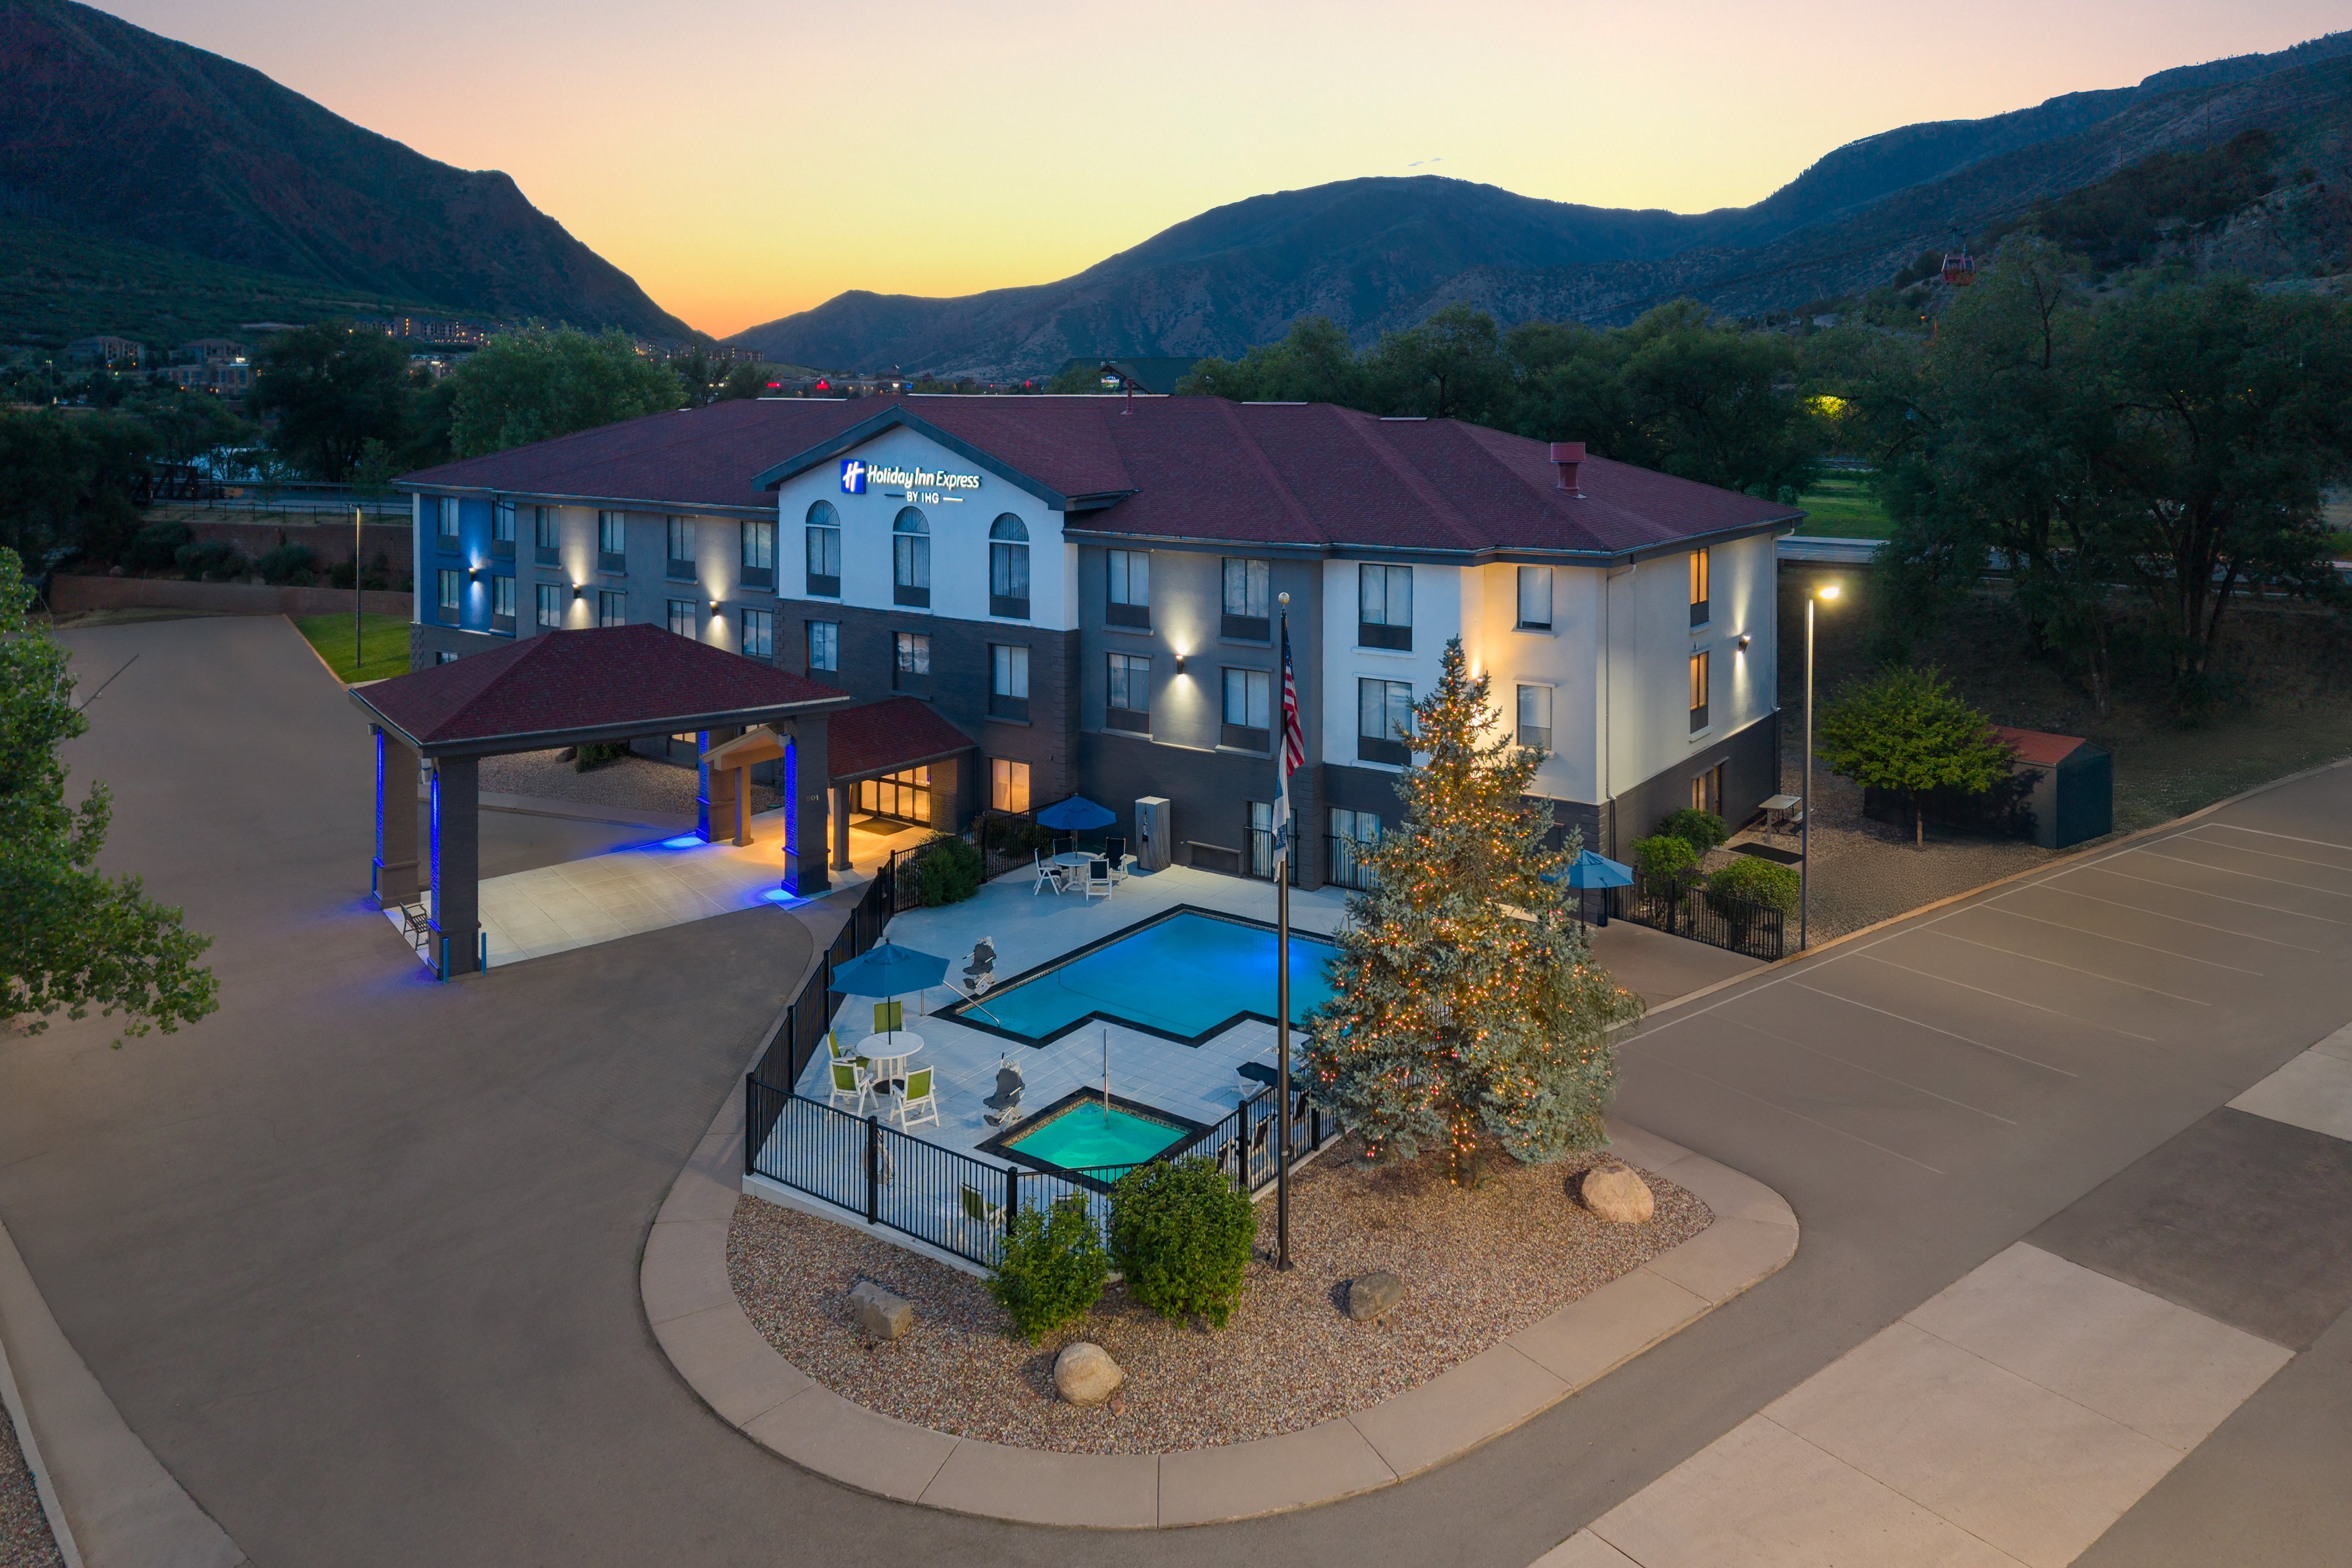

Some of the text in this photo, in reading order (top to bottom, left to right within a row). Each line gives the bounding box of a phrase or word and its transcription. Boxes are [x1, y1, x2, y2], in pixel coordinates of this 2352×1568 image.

[866, 464, 980, 491] Holiday Inn Express
[906, 491, 940, 504] BY IHG
